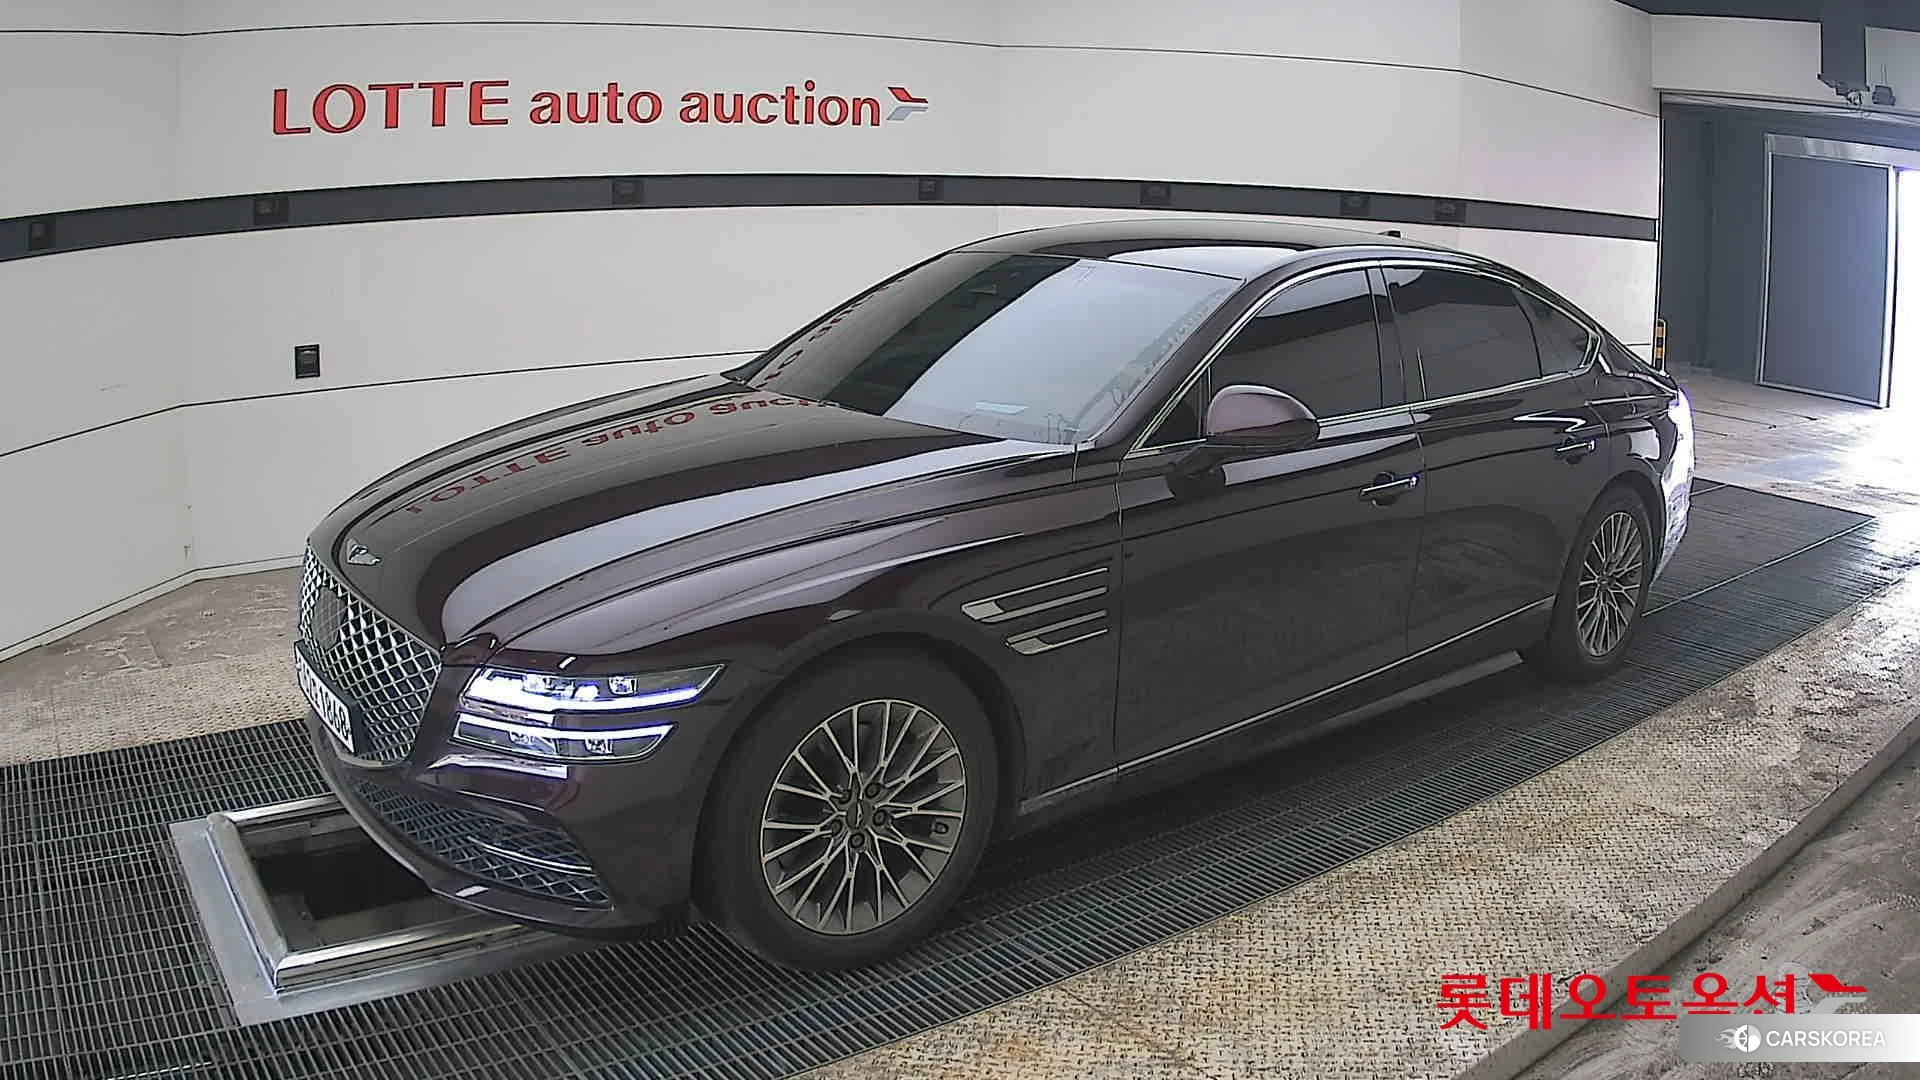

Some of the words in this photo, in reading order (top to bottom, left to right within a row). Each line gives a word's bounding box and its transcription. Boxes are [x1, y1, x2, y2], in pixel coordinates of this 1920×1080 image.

[273, 80, 509, 135] LOTTE
[529, 82, 662, 124] auto
[679, 80, 881, 126] auction
